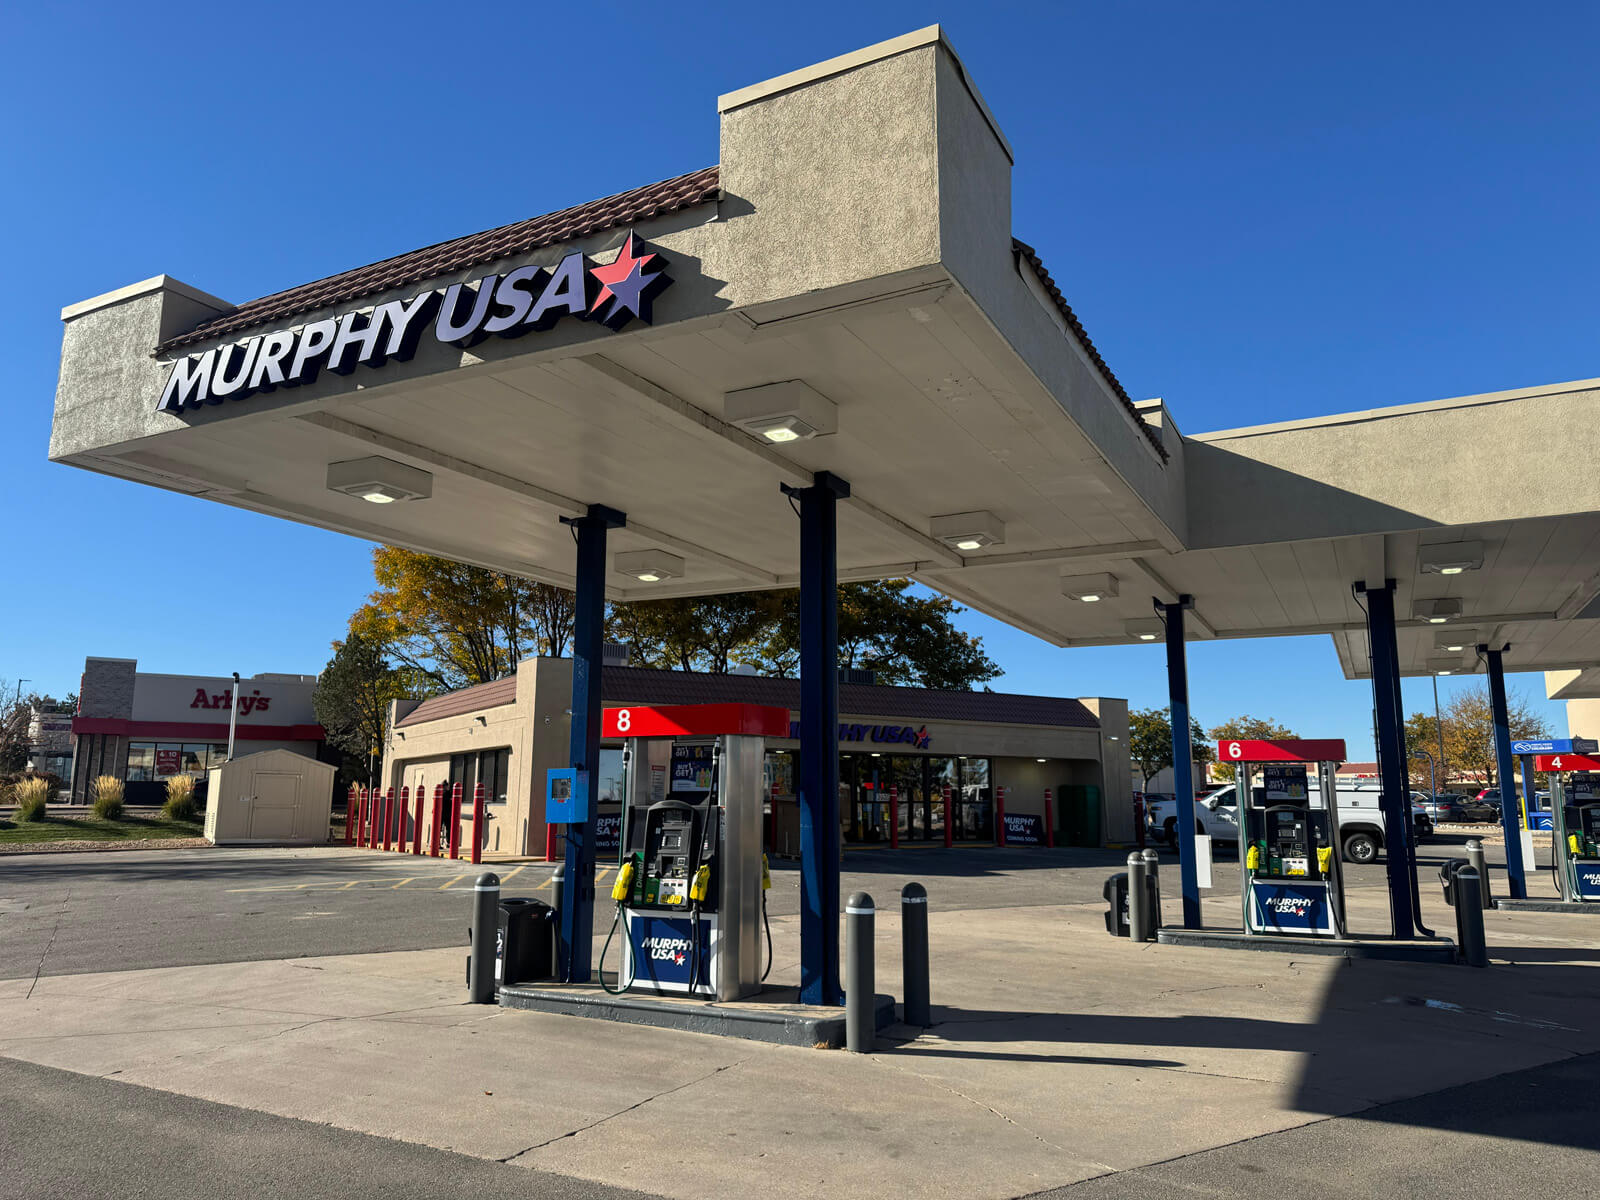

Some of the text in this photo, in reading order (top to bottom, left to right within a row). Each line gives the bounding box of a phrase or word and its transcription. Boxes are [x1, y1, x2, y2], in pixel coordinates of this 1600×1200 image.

[156, 251, 588, 411] MURPHY USA
[190, 688, 272, 716] Arby's
[617, 709, 630, 731] 8
[870, 725, 914, 744] USA
[1229, 742, 1241, 758] 6
[1551, 756, 1562, 768] 4
[675, 769, 689, 777] GET
[597, 817, 622, 826] RPH
[1004, 816, 1035, 825] MURPHY
[596, 826, 610, 835] SA
[1009, 824, 1025, 832] USA
[1265, 897, 1315, 906] MURPHY
[1275, 905, 1297, 913] USA
[641, 937, 693, 951] MURPHY
[651, 948, 676, 961] USA
